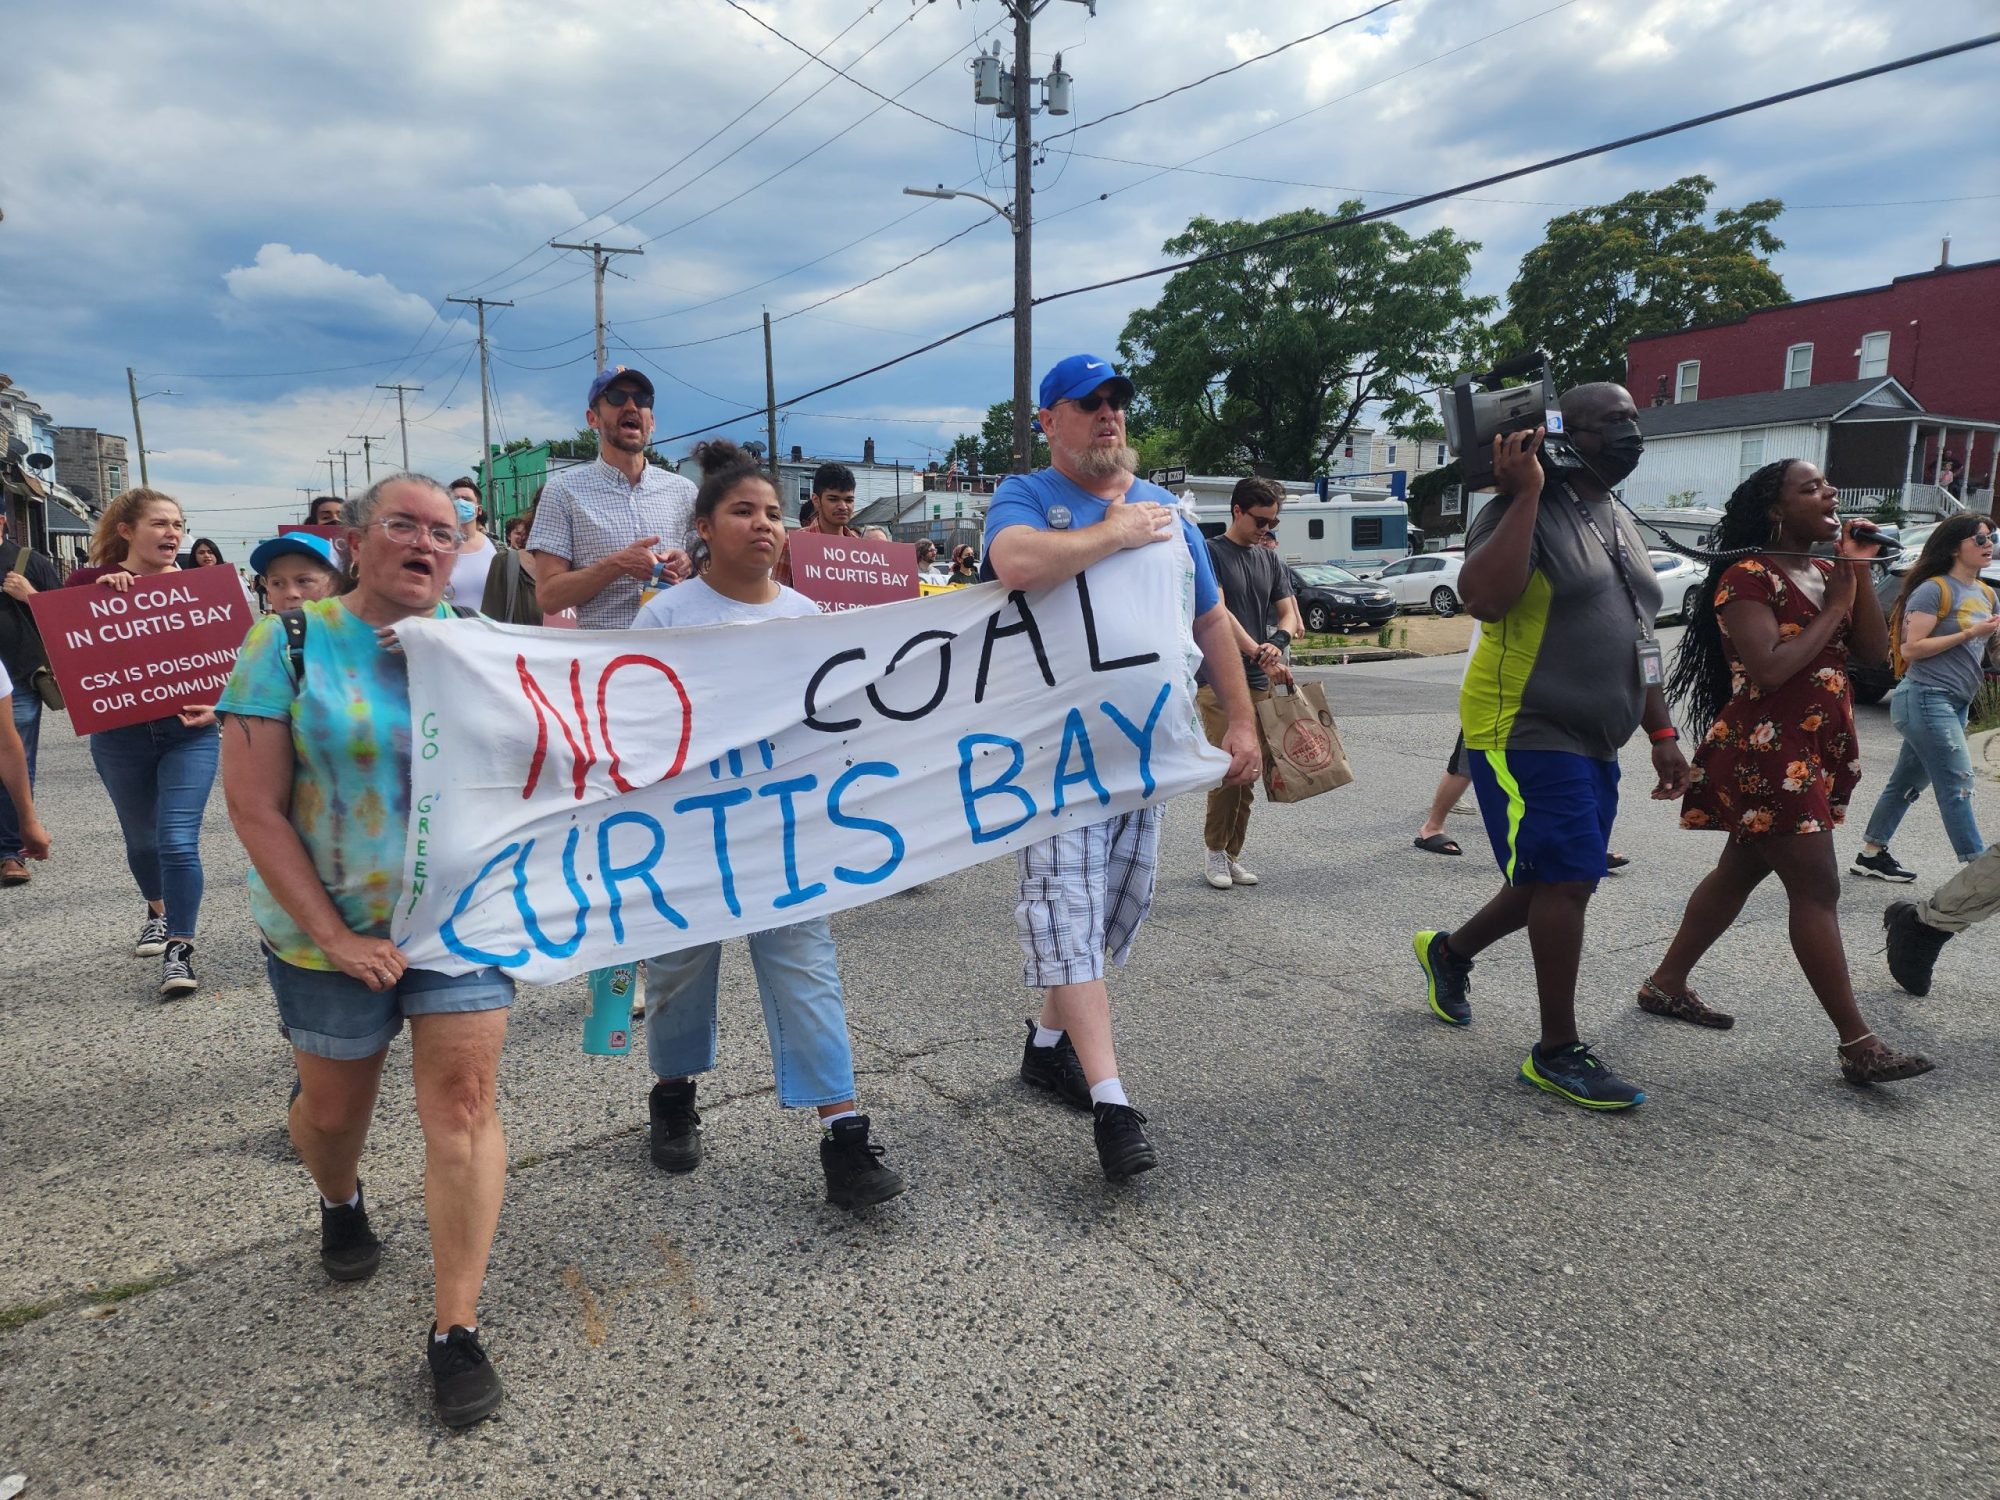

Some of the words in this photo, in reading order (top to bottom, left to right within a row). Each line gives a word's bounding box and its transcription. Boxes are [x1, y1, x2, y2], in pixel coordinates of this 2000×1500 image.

[824, 547, 846, 562] NO
[850, 550, 890, 567] COAL
[804, 565, 821, 579] IN
[825, 568, 879, 584] CURTIS
[881, 572, 909, 587] BAY
[89, 597, 128, 619] NO
[134, 586, 199, 610] COAL
[817, 600, 832, 613] SX
[65, 629, 94, 649] IN
[99, 613, 185, 642] CURTIS
[189, 604, 233, 627] BAY
[80, 671, 121, 691] CSX
[124, 667, 143, 682] IS
[516, 653, 693, 800] NO
[802, 571, 1160, 733] COAL
[92, 693, 137, 713] OUR
[421, 712, 439, 760] GO
[438, 760, 906, 970] CURTIS
[956, 681, 1173, 846] BAY
[405, 795, 433, 920] GREEN!
